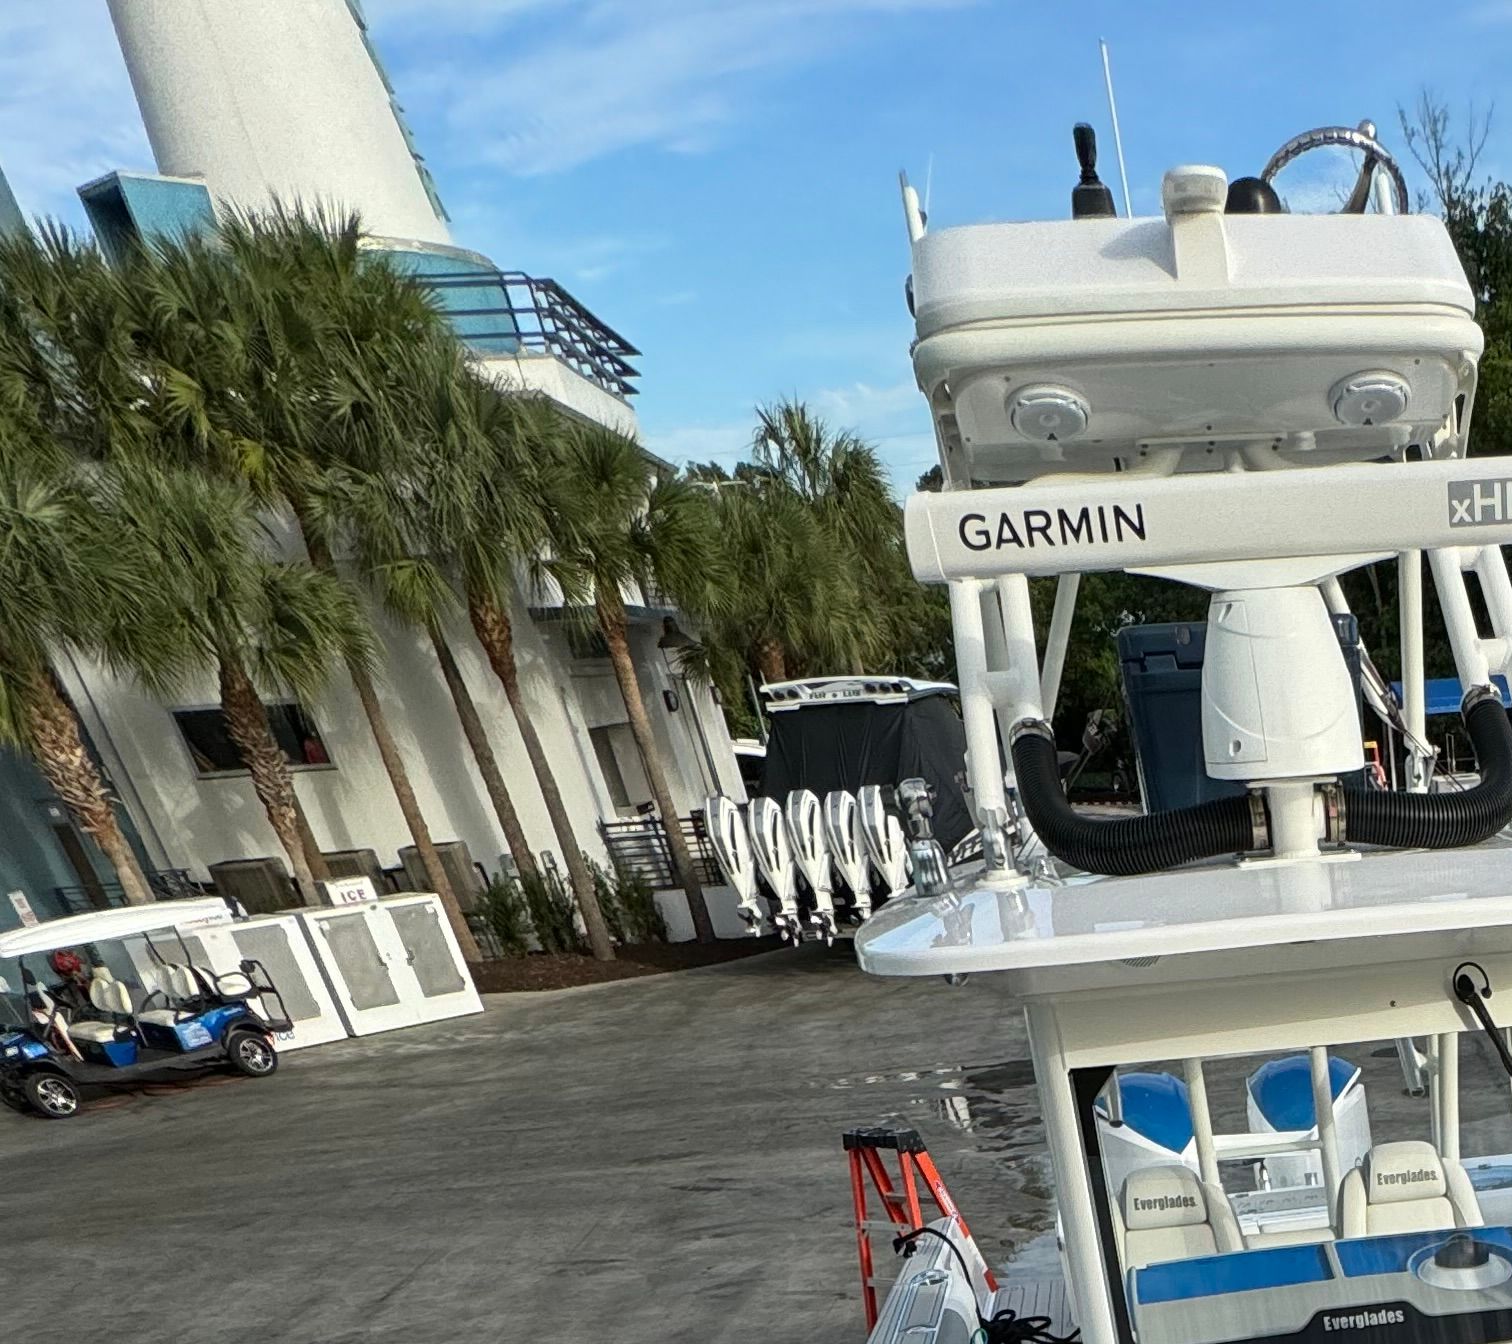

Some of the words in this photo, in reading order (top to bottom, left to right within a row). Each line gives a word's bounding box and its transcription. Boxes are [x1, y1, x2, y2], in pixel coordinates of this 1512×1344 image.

[958, 503, 1147, 551] GARMIN
[340, 888, 367, 903] ICE
[1376, 1168, 1438, 1186] Everglades
[1133, 1194, 1197, 1211] Everglades
[1323, 1309, 1404, 1331] Everglades
